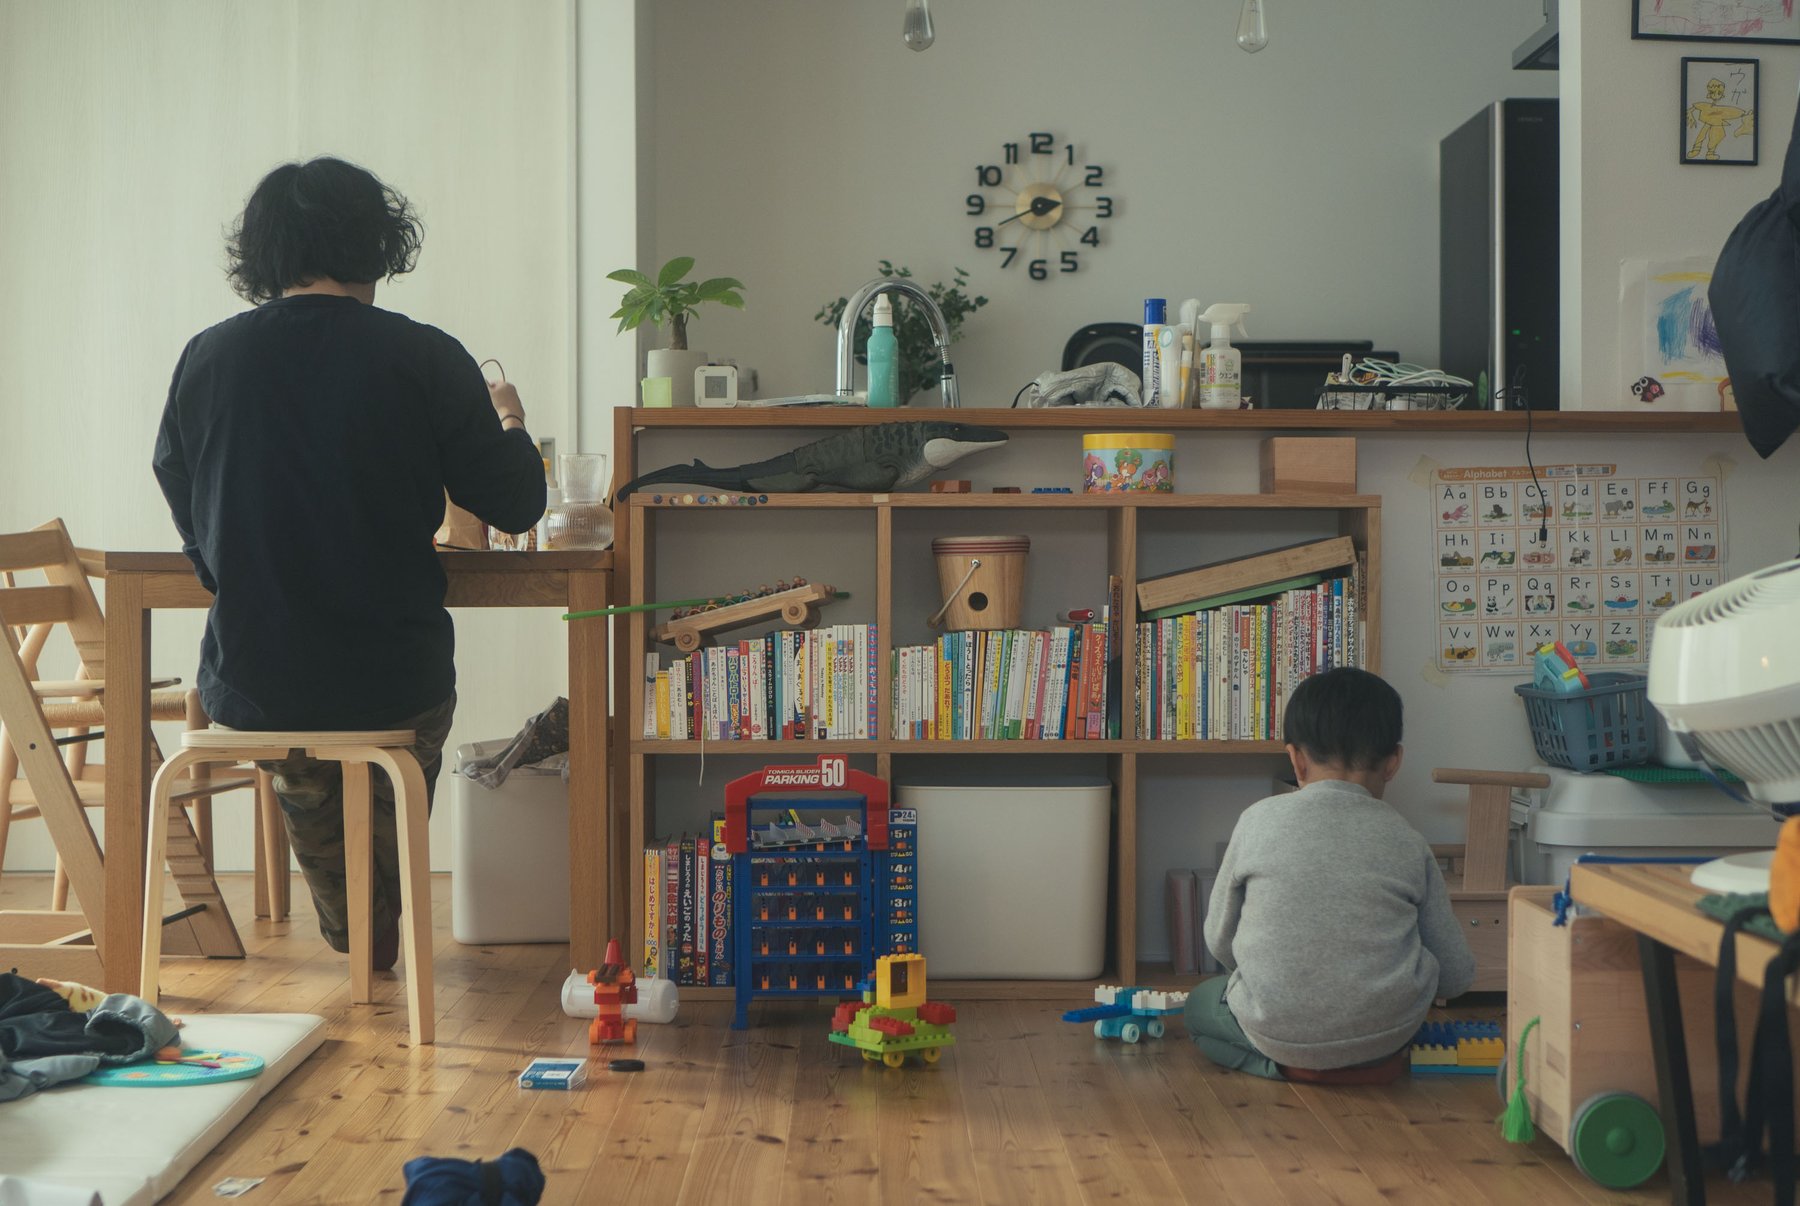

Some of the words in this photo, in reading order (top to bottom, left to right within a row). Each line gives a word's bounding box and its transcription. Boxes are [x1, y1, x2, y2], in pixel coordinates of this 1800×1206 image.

[1002, 143, 1018, 164] 11
[1028, 133, 1054, 155] 12
[1065, 145, 1073, 166] 1
[975, 165, 1002, 187] 10
[1085, 166, 1103, 187] 2
[966, 195, 985, 215] 9
[1096, 197, 1112, 218] 3
[975, 227, 994, 248] 8
[1080, 226, 1099, 247] 4
[999, 248, 1018, 268] 7
[1060, 252, 1078, 272] 5
[1029, 259, 1047, 281] 6
[1463, 470, 1507, 479] Alphabet
[1094, 634, 1104, 667] クリスマス
[729, 656, 739, 705] パウ・パトロール
[796, 653, 804, 710] しましまぐるぐる
[765, 775, 820, 785] PARKING
[822, 759, 845, 787] 50
[890, 811, 902, 823] P
[667, 872, 678, 925] 二宮金次郎
[683, 854, 693, 942] しまじろうのえいごのうた
